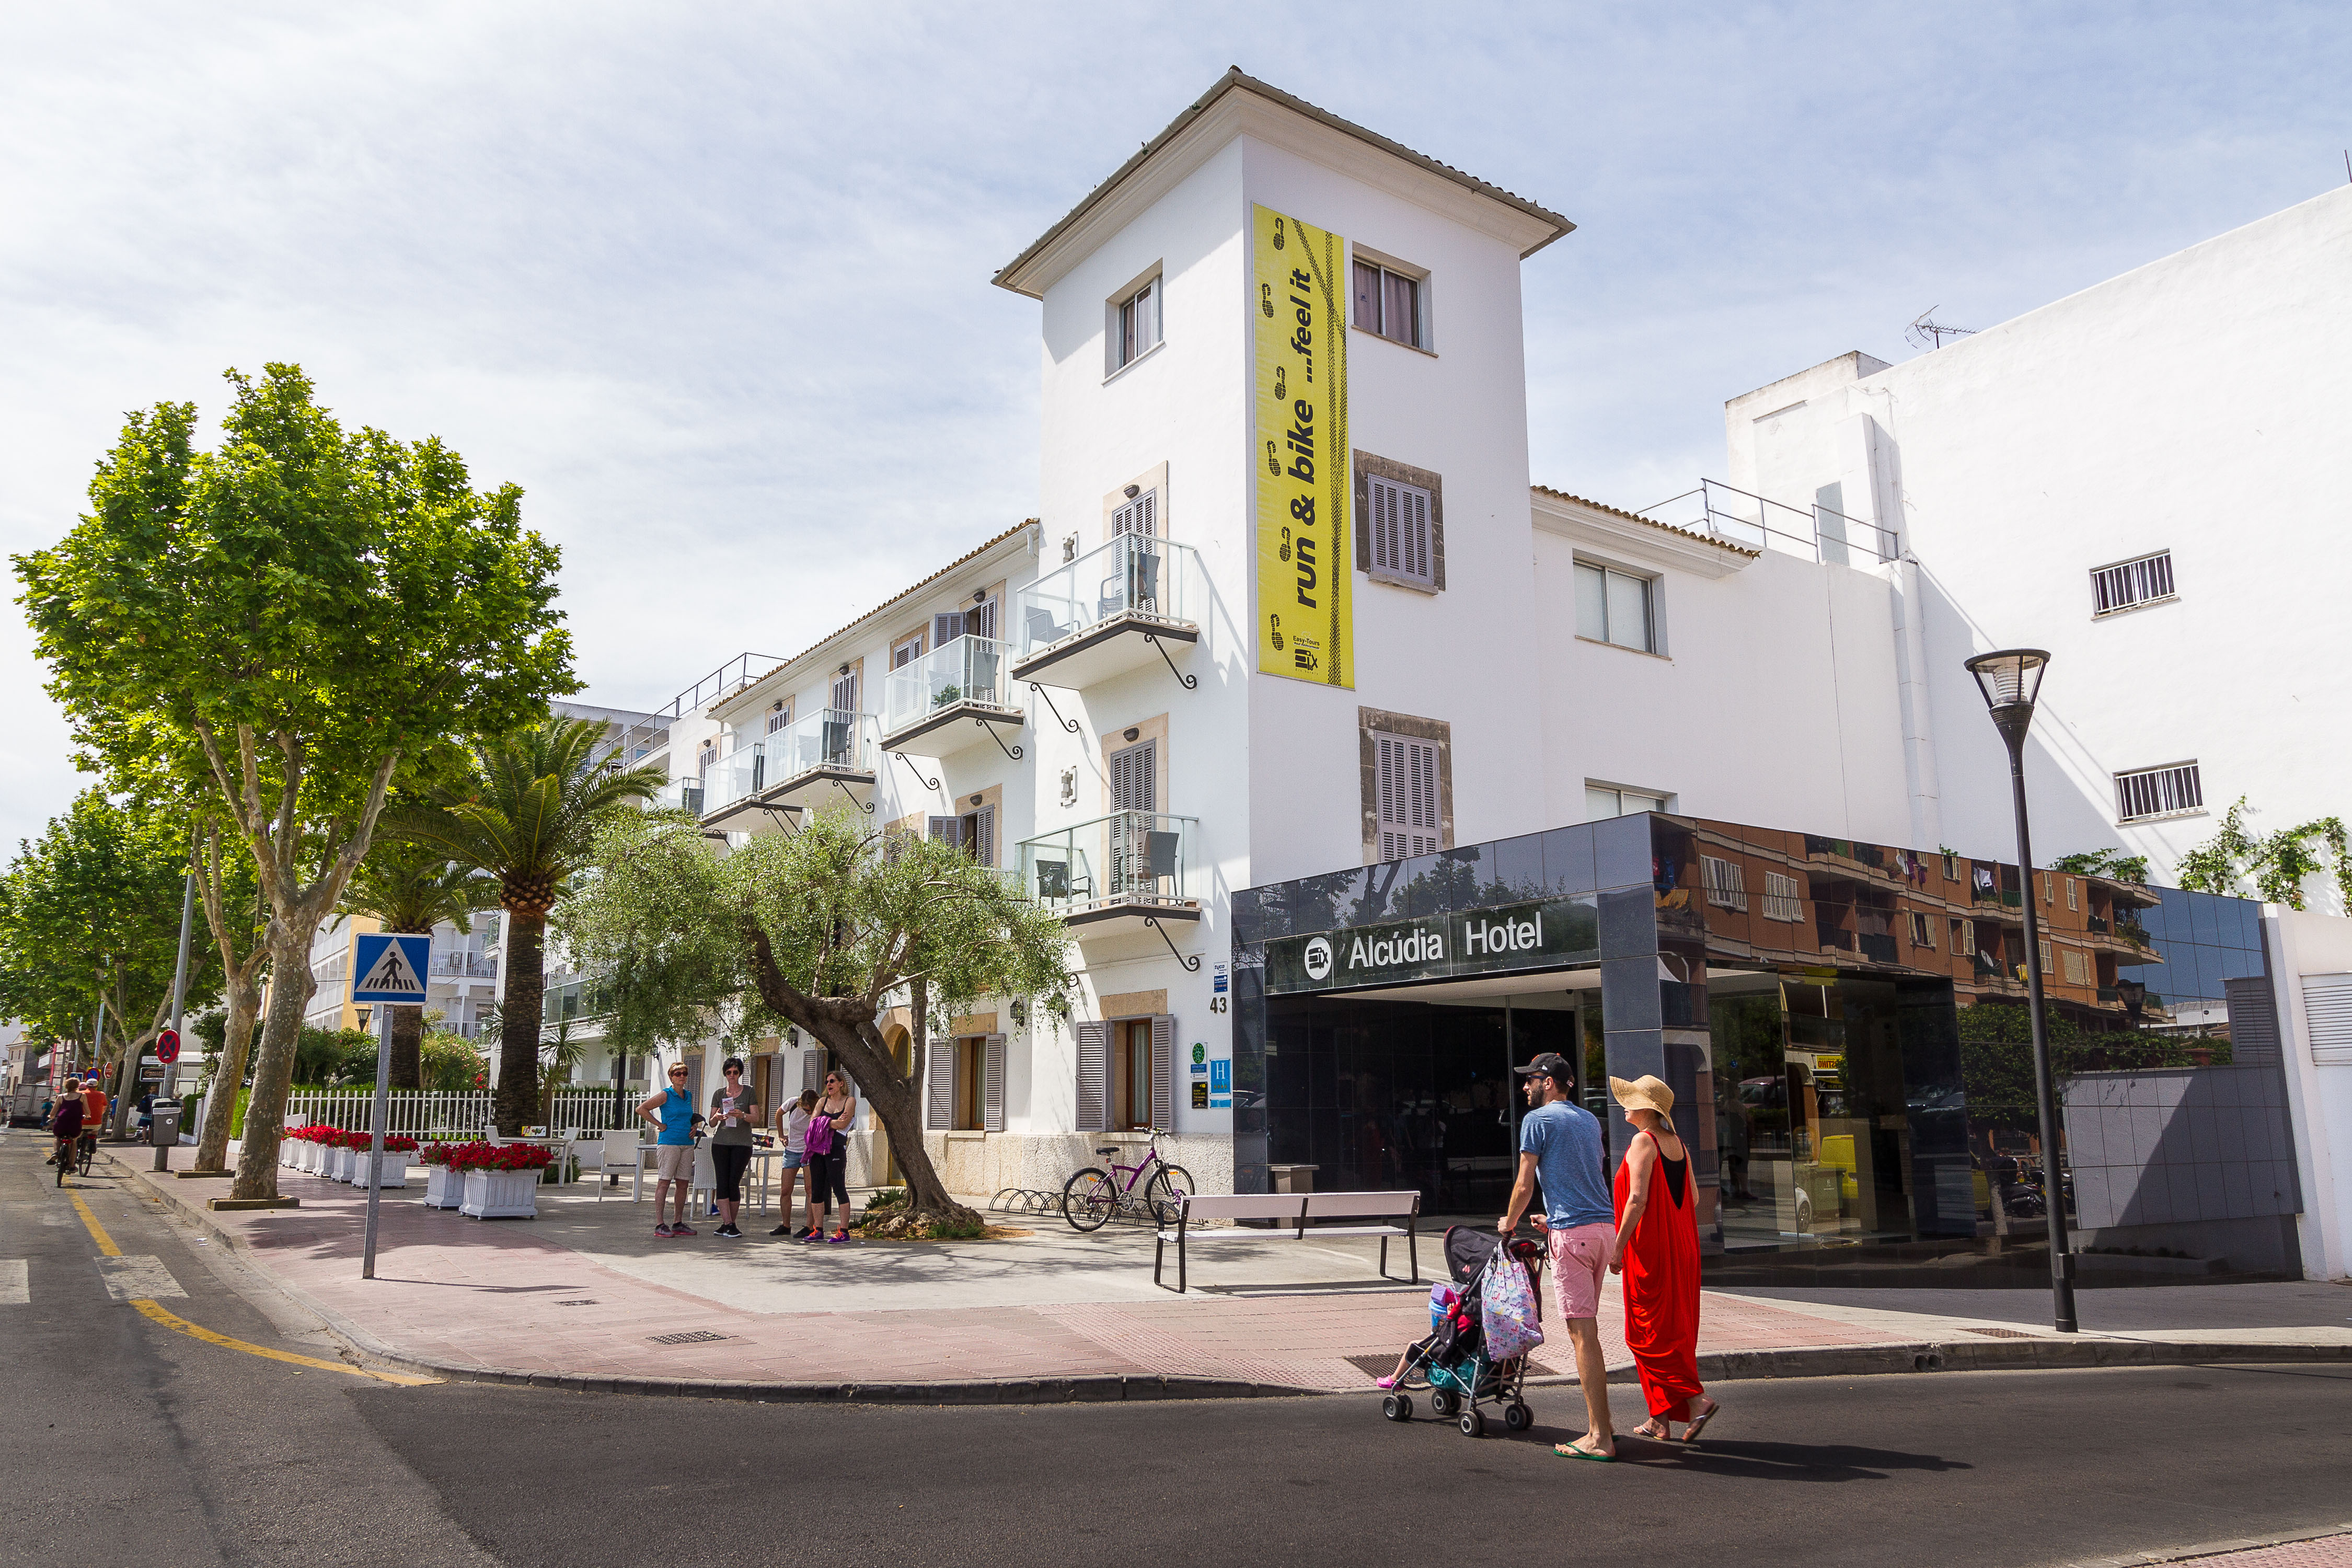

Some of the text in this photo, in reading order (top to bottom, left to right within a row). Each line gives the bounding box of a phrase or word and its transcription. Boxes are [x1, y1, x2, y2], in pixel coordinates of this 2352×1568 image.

[1289, 268, 1311, 294] it
[1287, 399, 1315, 485] bike
[1290, 493, 1316, 526] &
[1296, 537, 1317, 609] run
[1348, 928, 1443, 969] Alcúdia
[1465, 912, 1543, 955] Hotel
[1209, 997, 1227, 1014] 43
[1216, 1062, 1226, 1079] H
